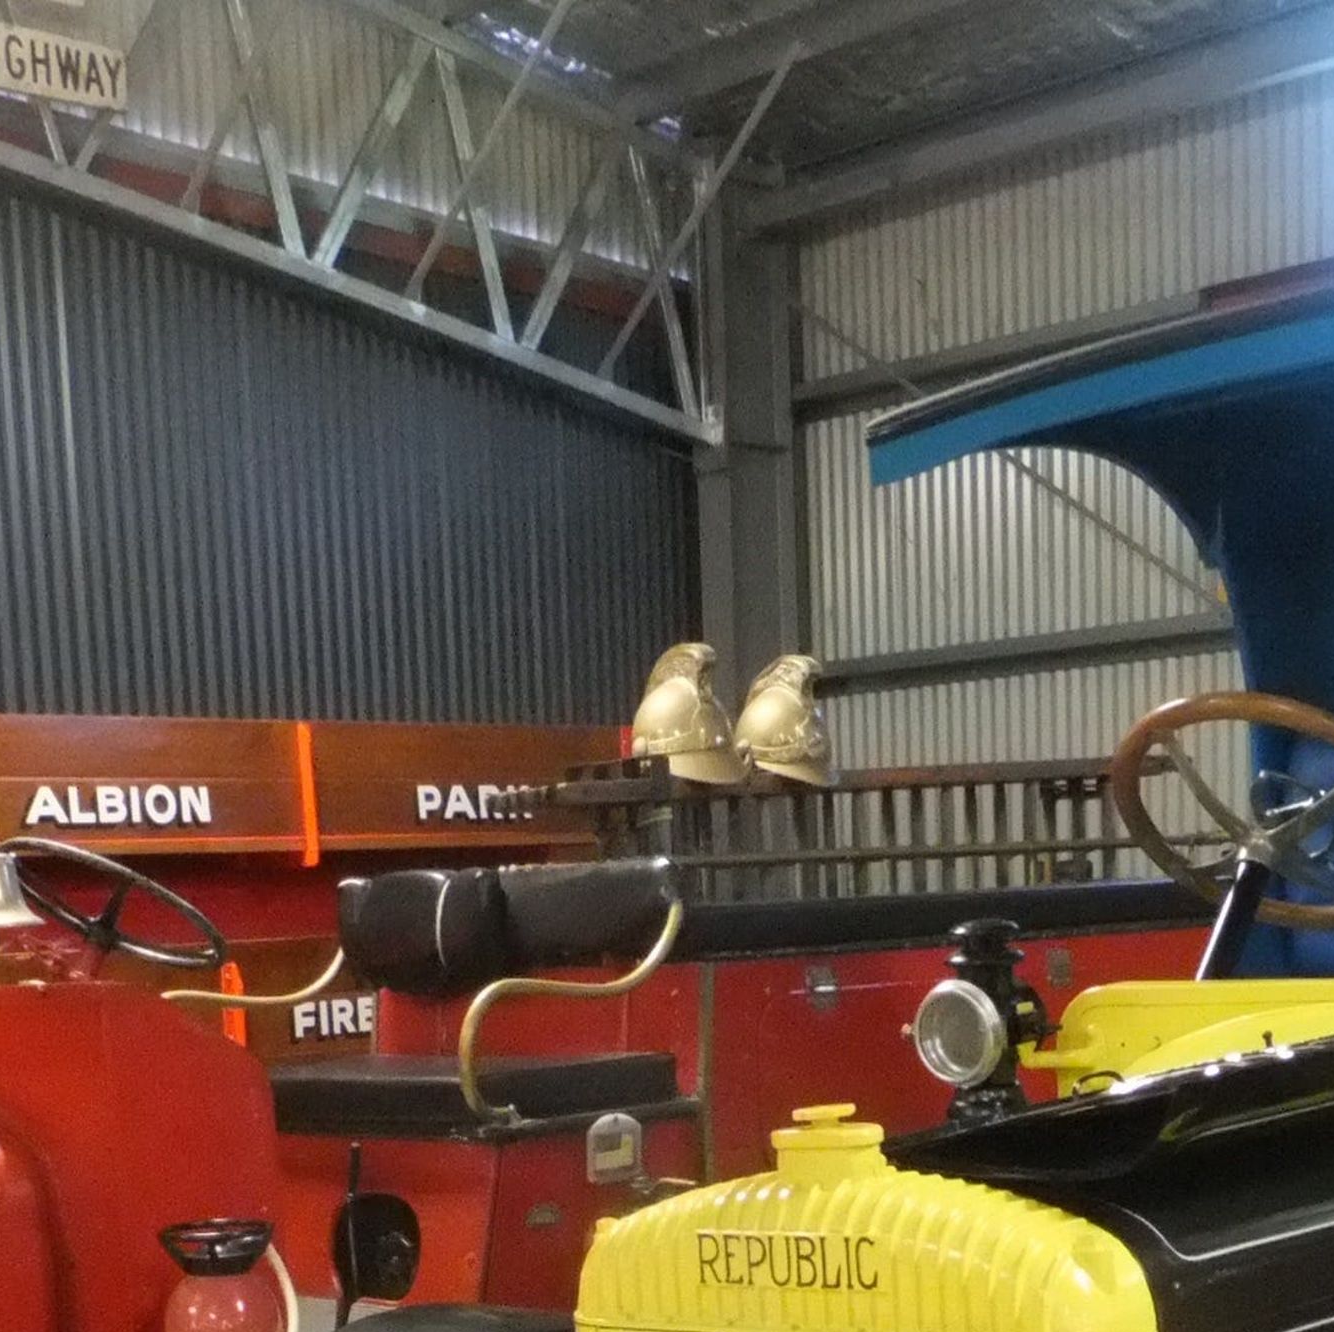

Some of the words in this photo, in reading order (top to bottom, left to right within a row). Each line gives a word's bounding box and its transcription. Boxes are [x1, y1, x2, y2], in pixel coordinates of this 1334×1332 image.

[24, 784, 212, 826] ALBION
[293, 996, 373, 1039] FIRE
[696, 1232, 879, 1291] REPUBLIC
